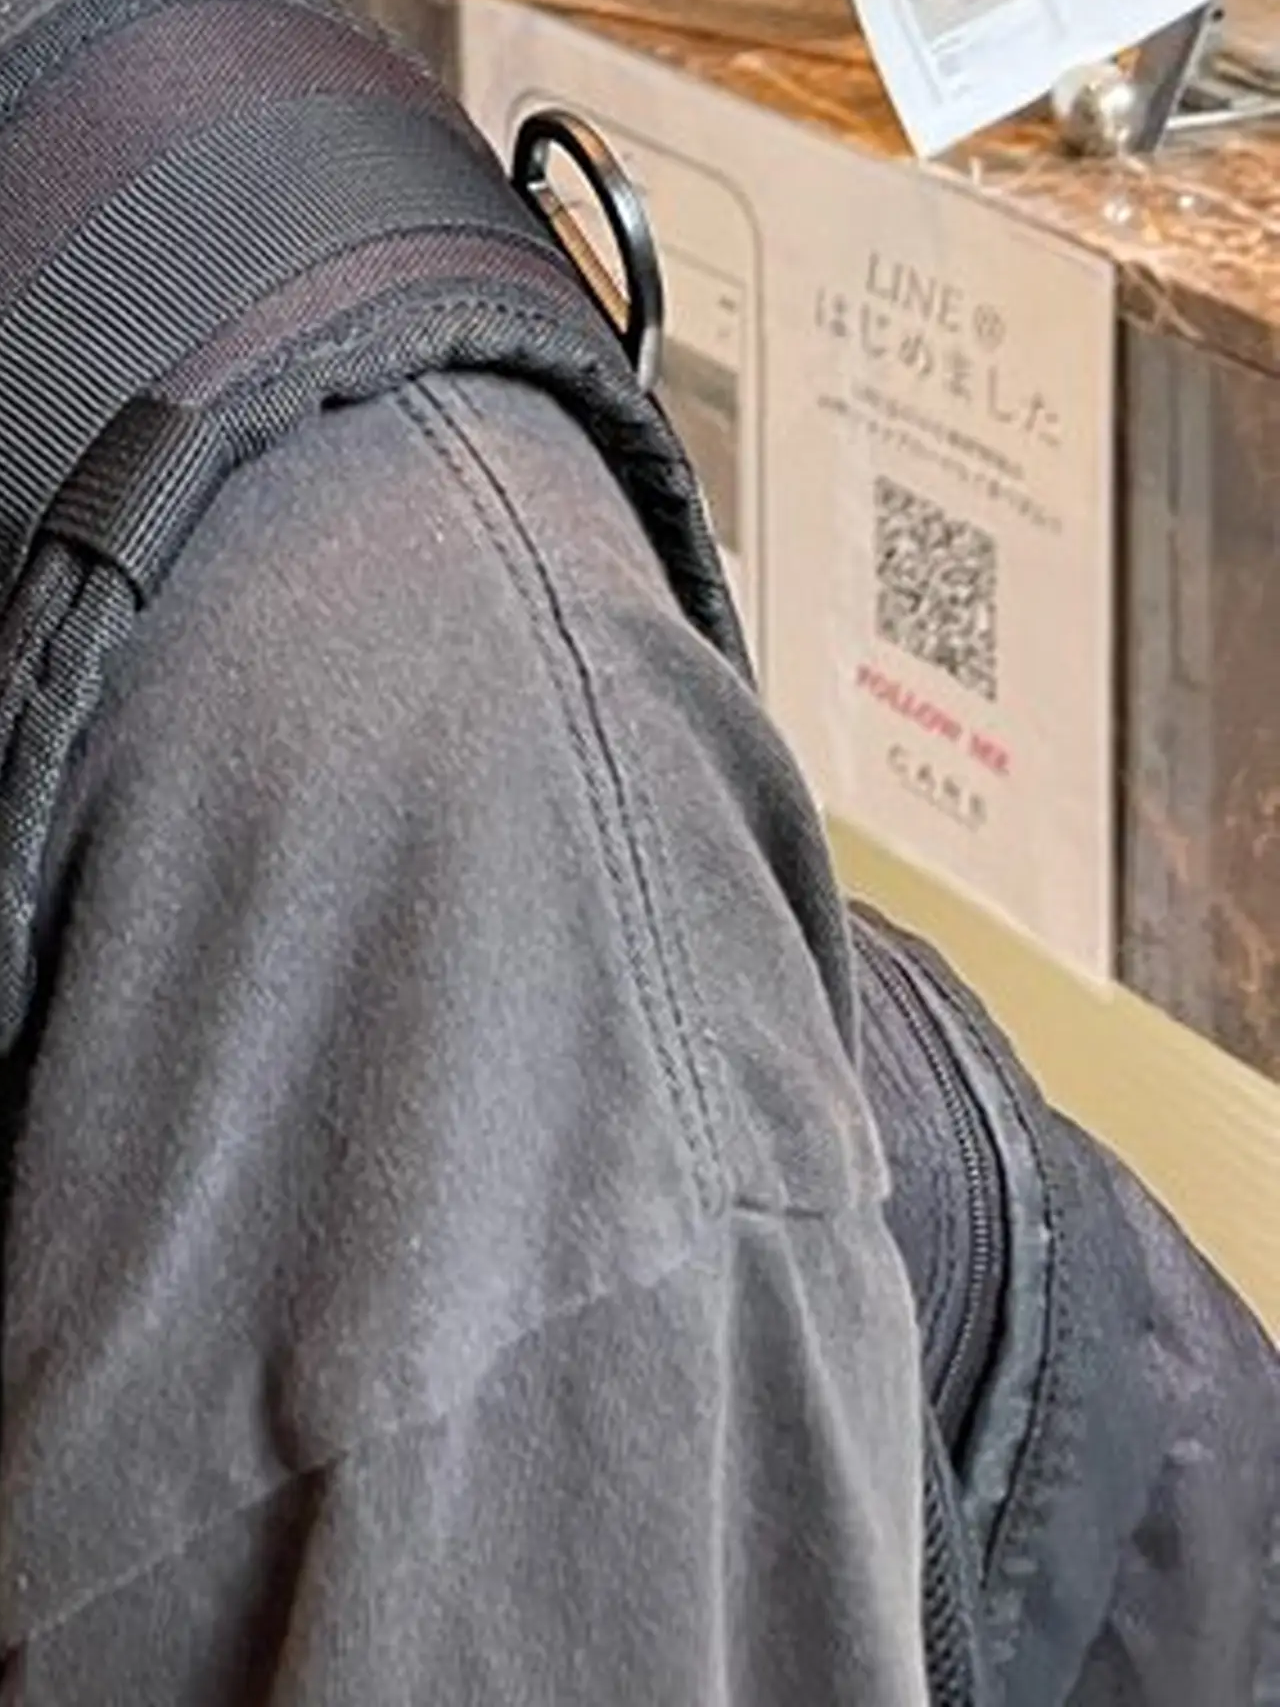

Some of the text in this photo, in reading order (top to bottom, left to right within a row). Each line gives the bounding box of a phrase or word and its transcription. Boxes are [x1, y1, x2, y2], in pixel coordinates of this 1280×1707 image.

[865, 251, 964, 333] LINE
[813, 285, 1062, 447] はじめました
